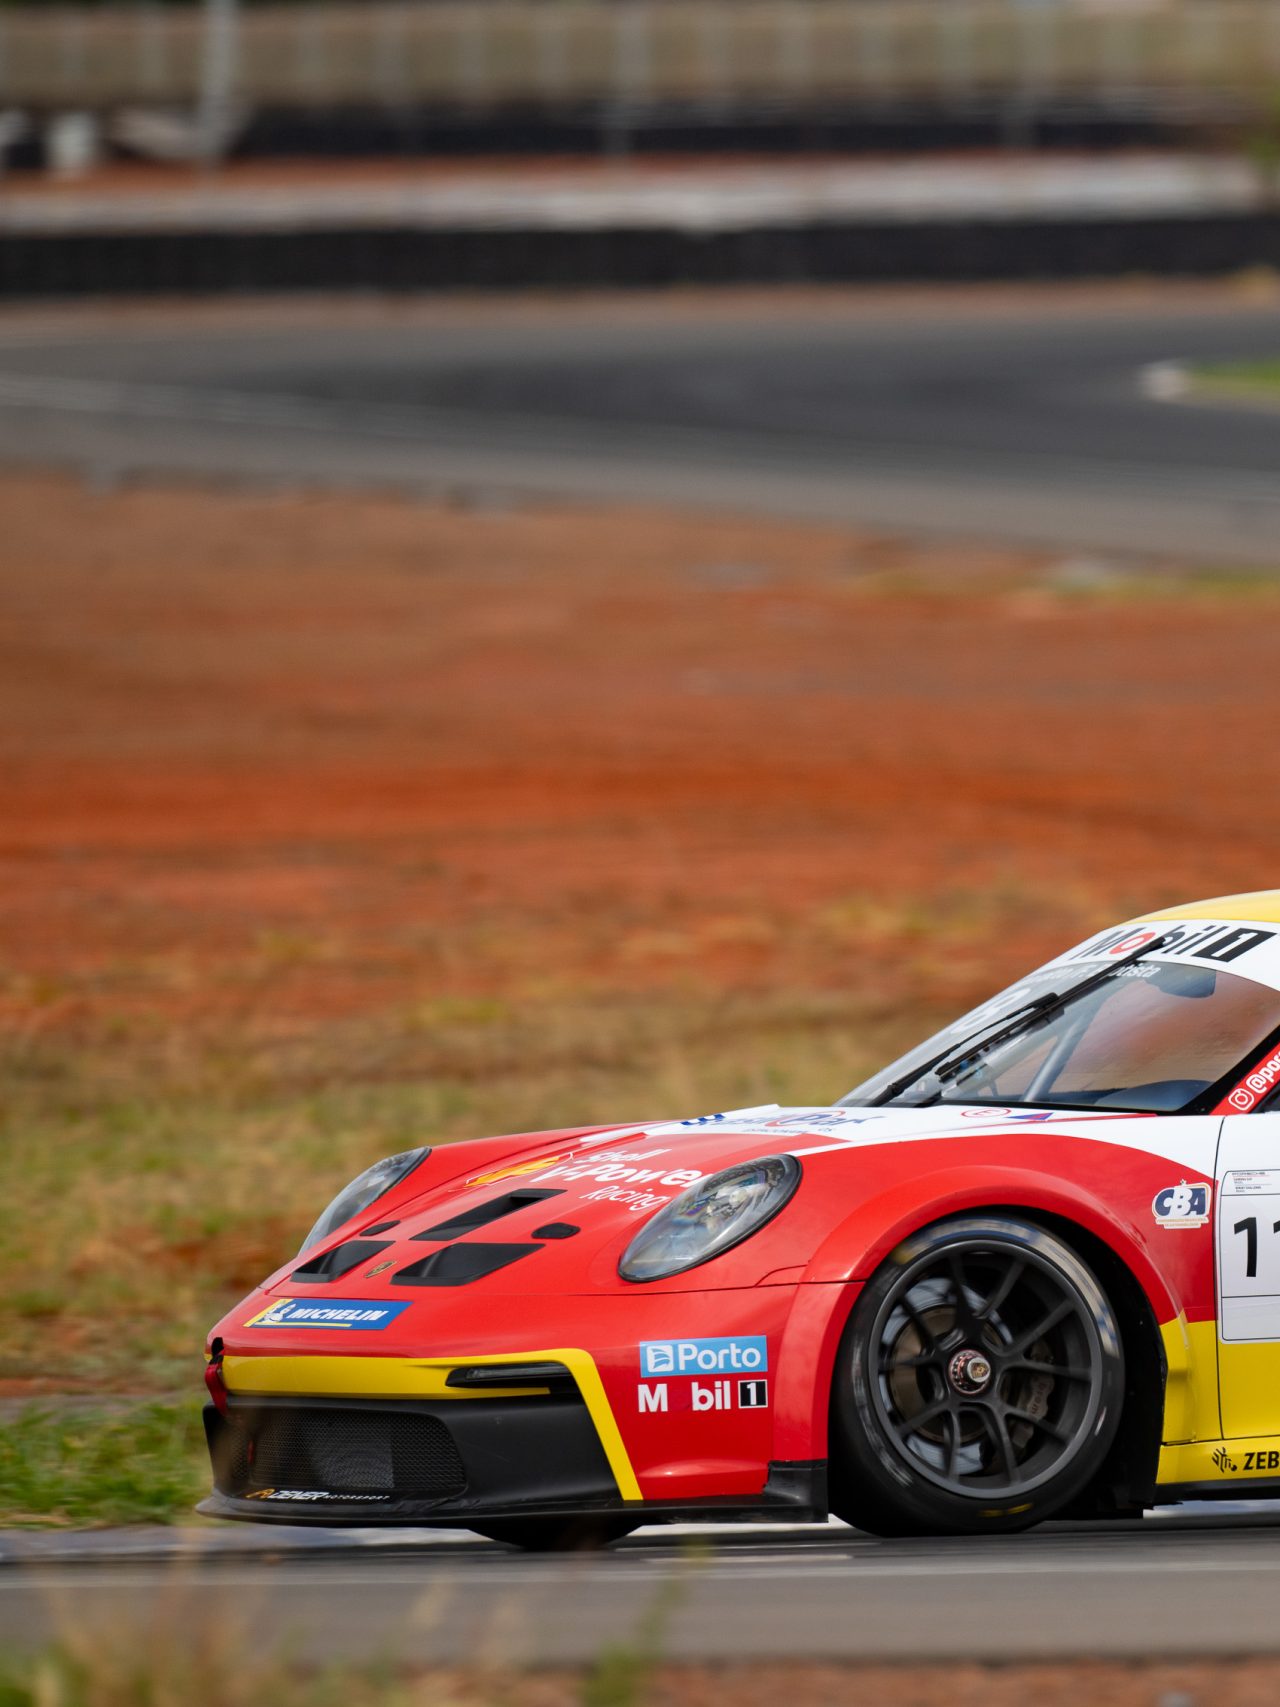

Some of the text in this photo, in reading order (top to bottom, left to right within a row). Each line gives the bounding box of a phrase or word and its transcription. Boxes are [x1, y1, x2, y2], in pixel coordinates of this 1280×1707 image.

[573, 1148, 673, 1165] Shell
[580, 1185, 671, 1211] Racing
[1154, 1187, 1207, 1217] CBA
[285, 1308, 390, 1321] MICHELIN
[677, 1342, 762, 1371] Porto
